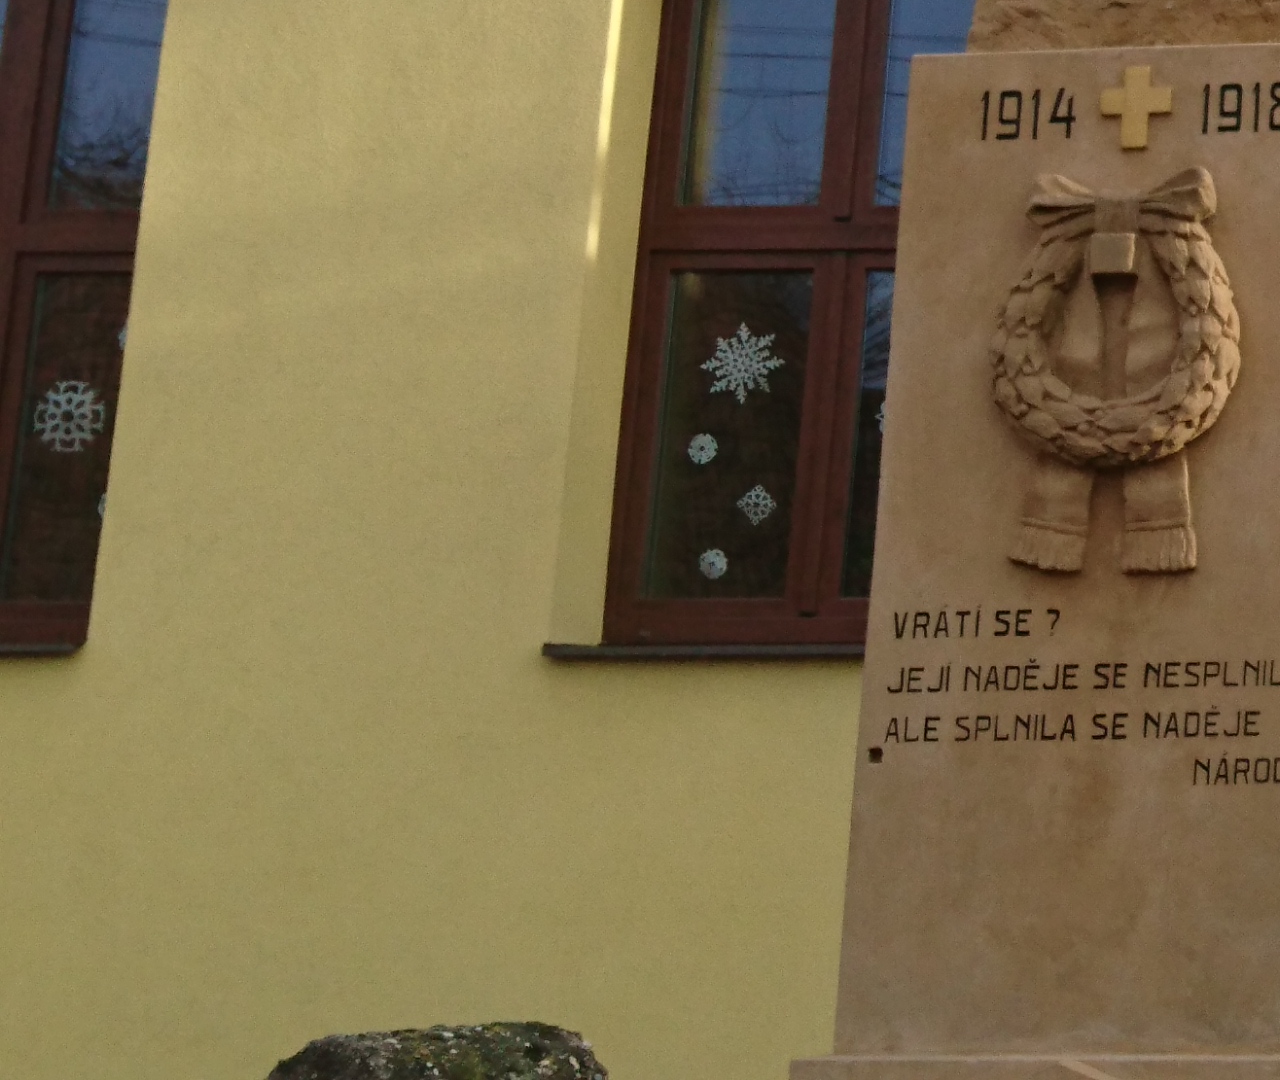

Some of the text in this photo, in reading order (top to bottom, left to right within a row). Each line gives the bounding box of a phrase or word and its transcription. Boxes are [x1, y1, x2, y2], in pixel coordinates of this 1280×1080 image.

[981, 87, 1077, 141] 1914
[894, 605, 981, 639] VRÁTÍ
[994, 609, 1032, 637] SE
[887, 663, 951, 694] JEJÍ
[963, 658, 1079, 692] NADĚJE
[1093, 662, 1128, 690] SE
[884, 705, 1261, 743] ALE SPLNILA SE NADĚJE
